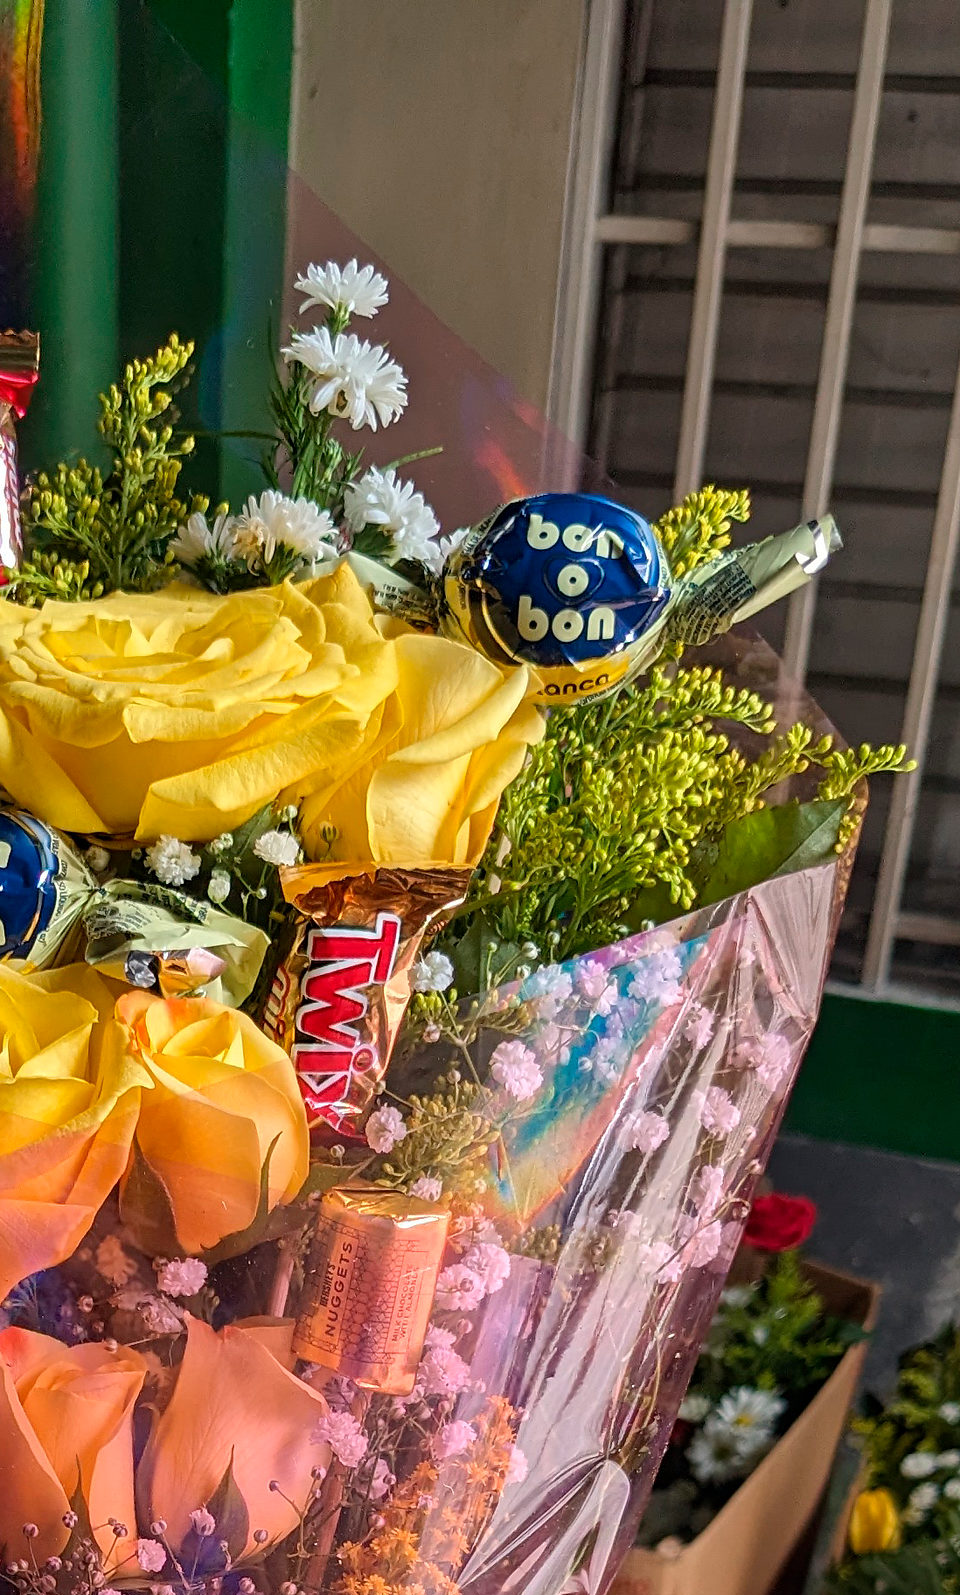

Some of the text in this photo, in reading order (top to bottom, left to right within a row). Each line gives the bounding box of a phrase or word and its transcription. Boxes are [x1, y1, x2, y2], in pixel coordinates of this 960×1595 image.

[526, 513, 624, 560] bon
[557, 563, 589, 597] o
[517, 595, 616, 643] bon
[536, 673, 609, 697] anca
[292, 911, 401, 1132] TWIX
[324, 1240, 353, 1338] NUGGETS
